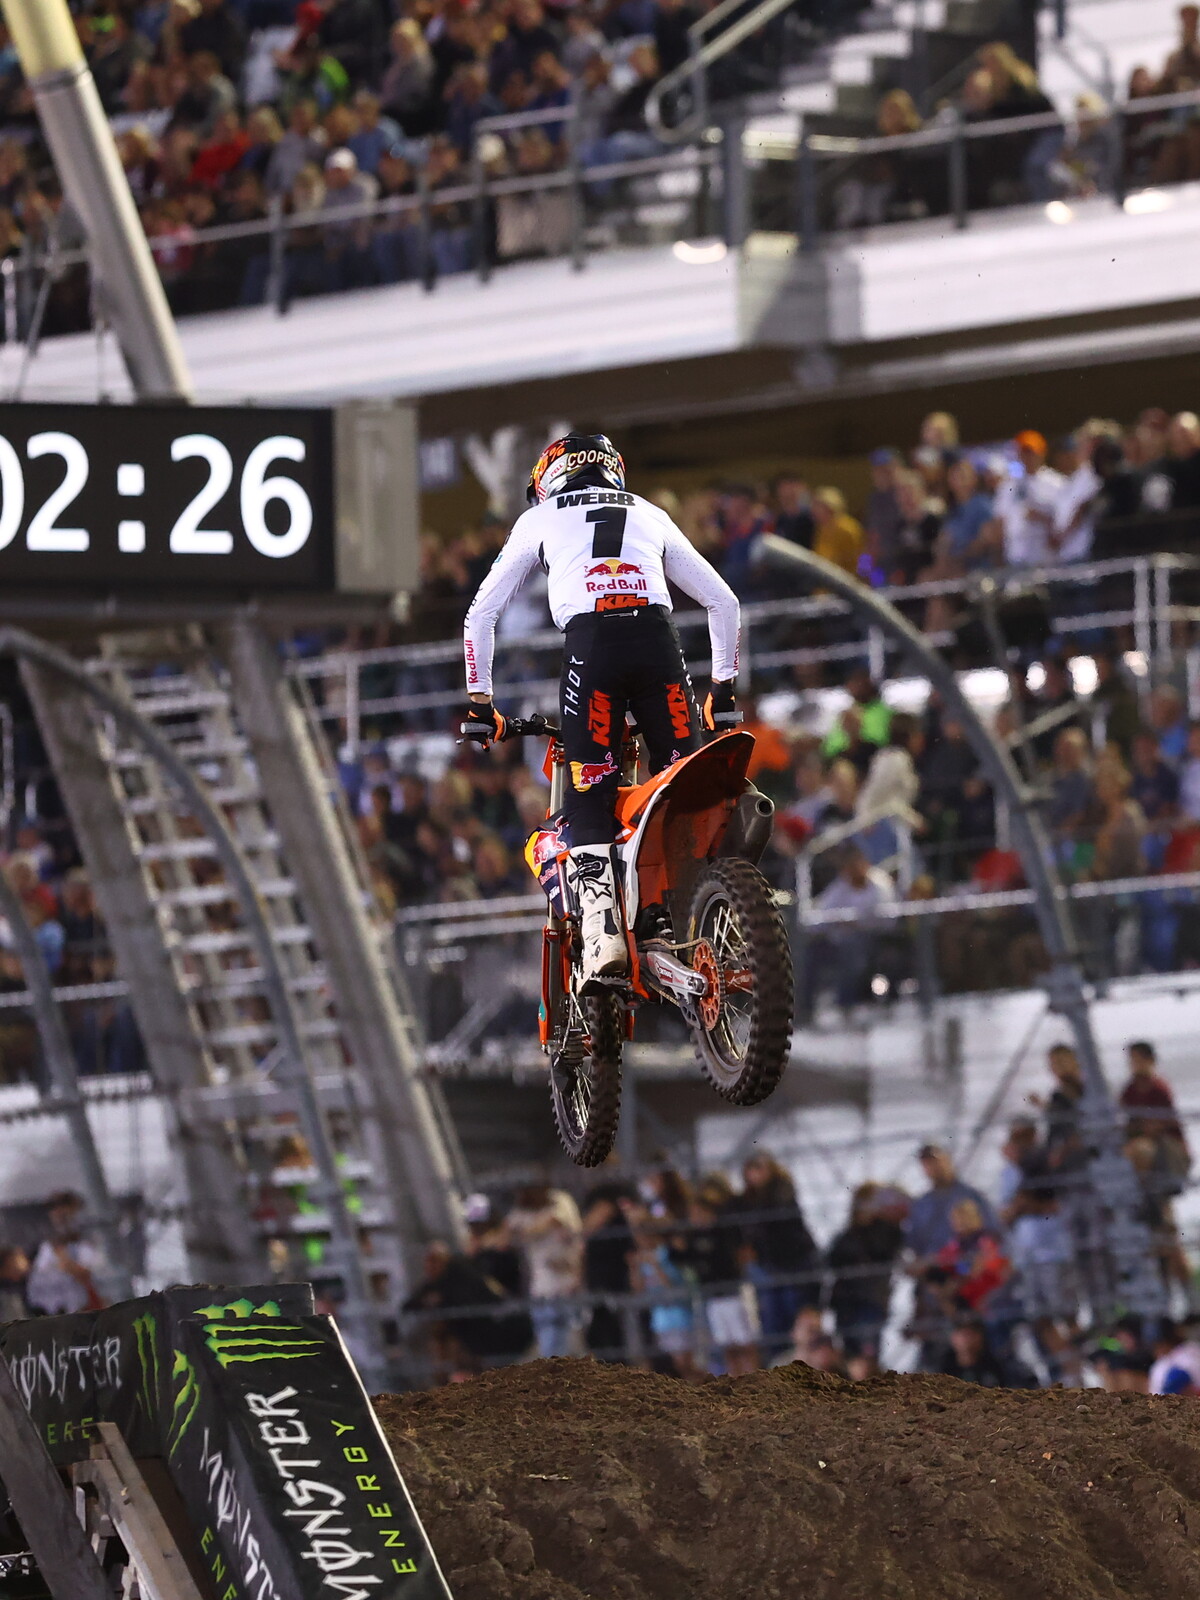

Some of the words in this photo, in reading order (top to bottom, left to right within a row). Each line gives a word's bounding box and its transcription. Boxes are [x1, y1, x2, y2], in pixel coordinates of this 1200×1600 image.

[567, 450, 618, 473] COOPER
[556, 492, 636, 509] WEBB
[585, 506, 628, 559] 1
[588, 689, 612, 748] KTM
[199, 1427, 282, 1600] MONST
[331, 1418, 419, 1575] ENERGY
